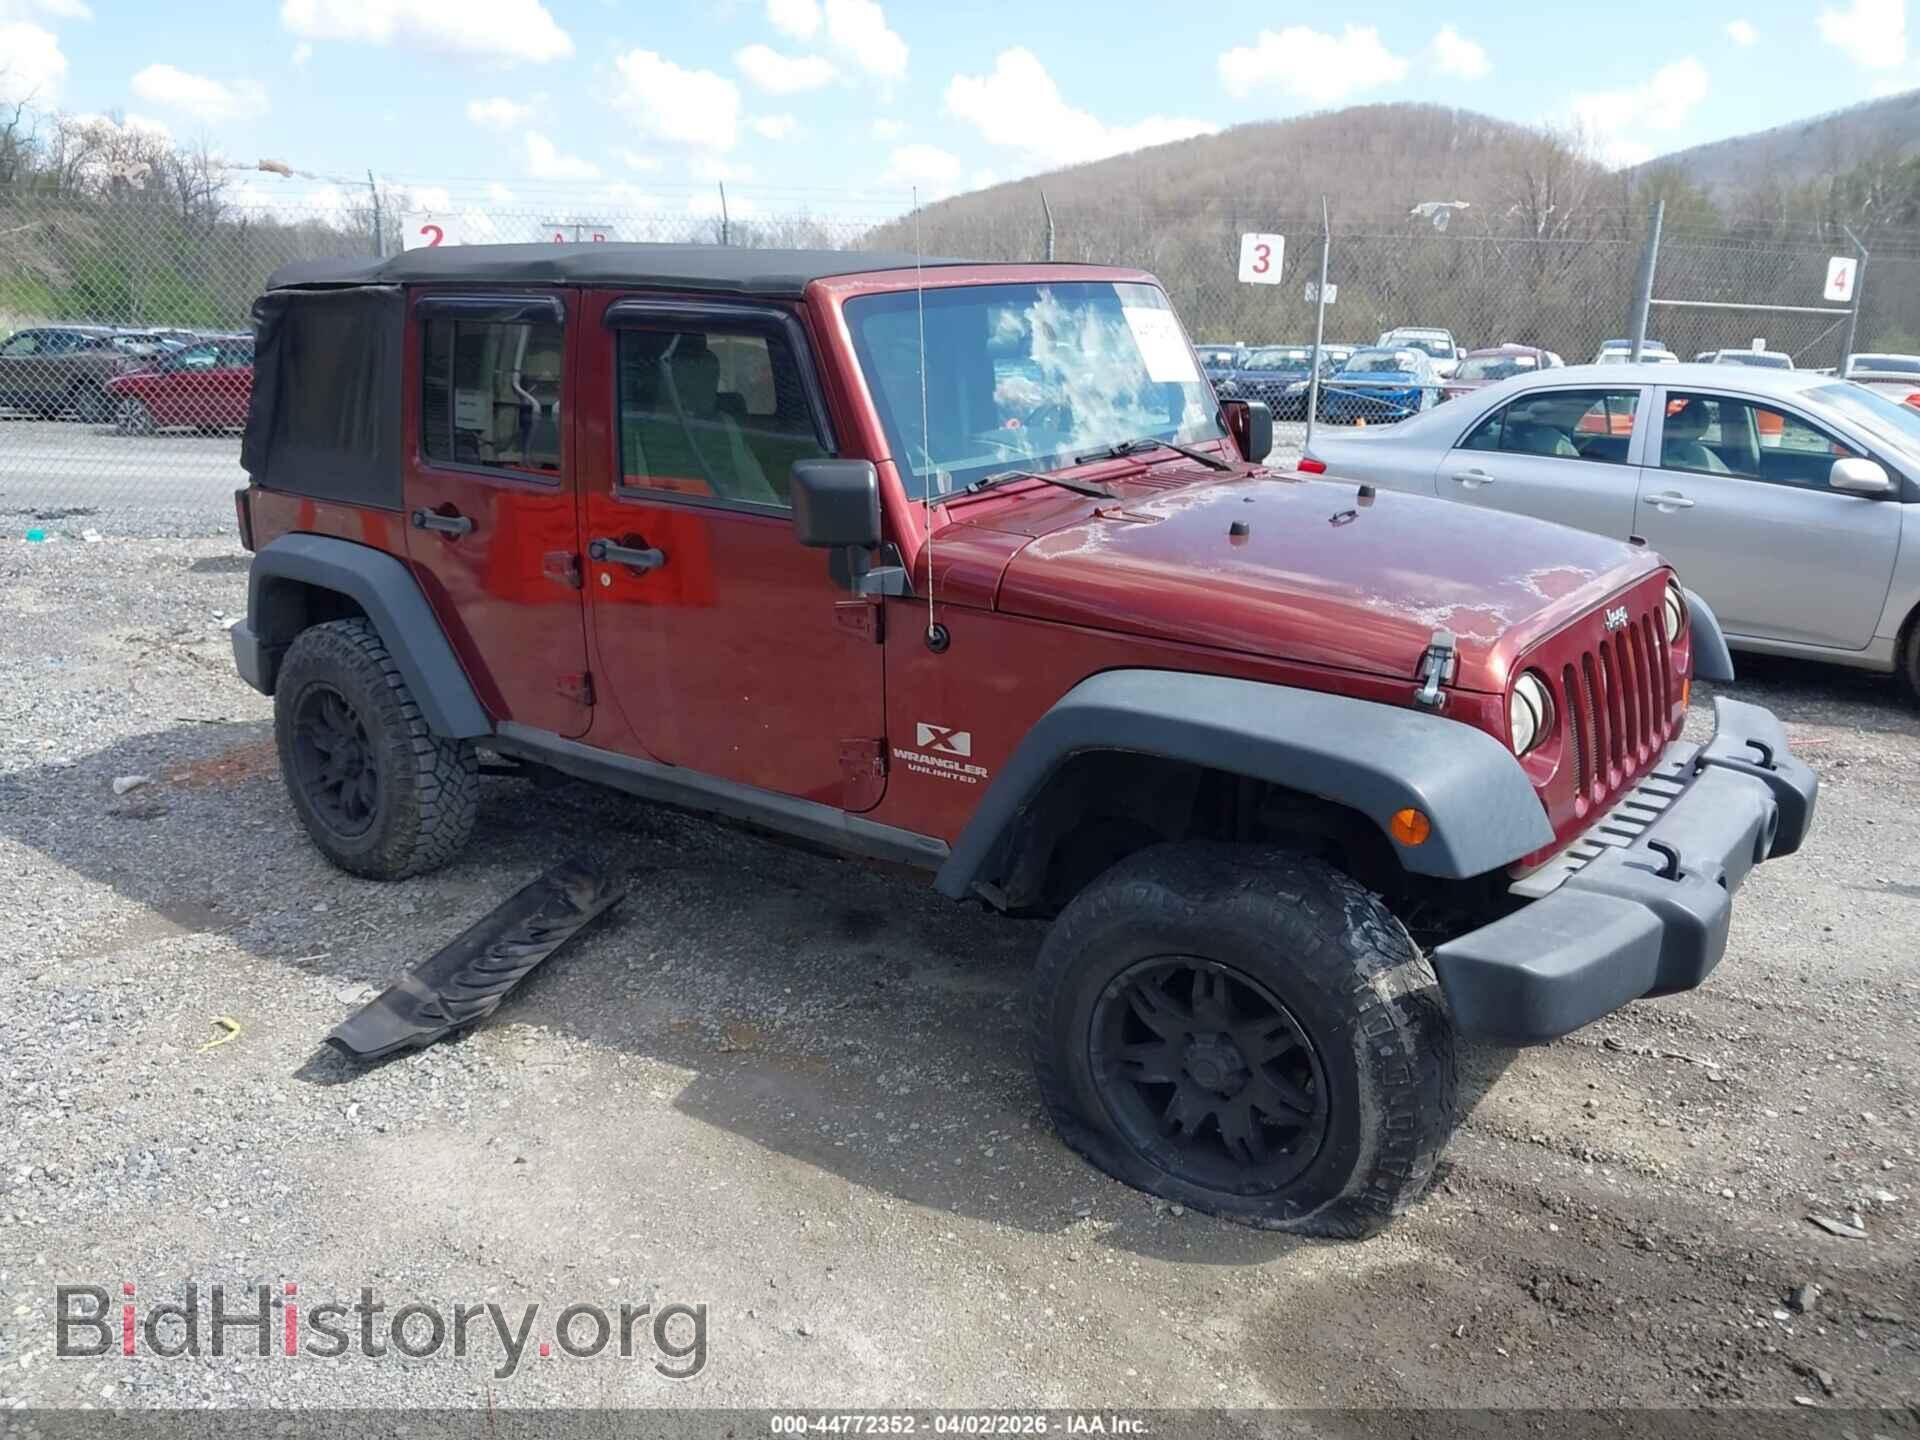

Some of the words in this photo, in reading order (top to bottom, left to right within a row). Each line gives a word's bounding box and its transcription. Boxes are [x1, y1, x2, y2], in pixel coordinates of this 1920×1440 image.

[420, 224, 444, 247] 2
[1252, 244, 1271, 273] 3
[1834, 267, 1847, 292] 4
[893, 748, 988, 778] WRANGLER
[908, 763, 977, 784] UNLIMITED
